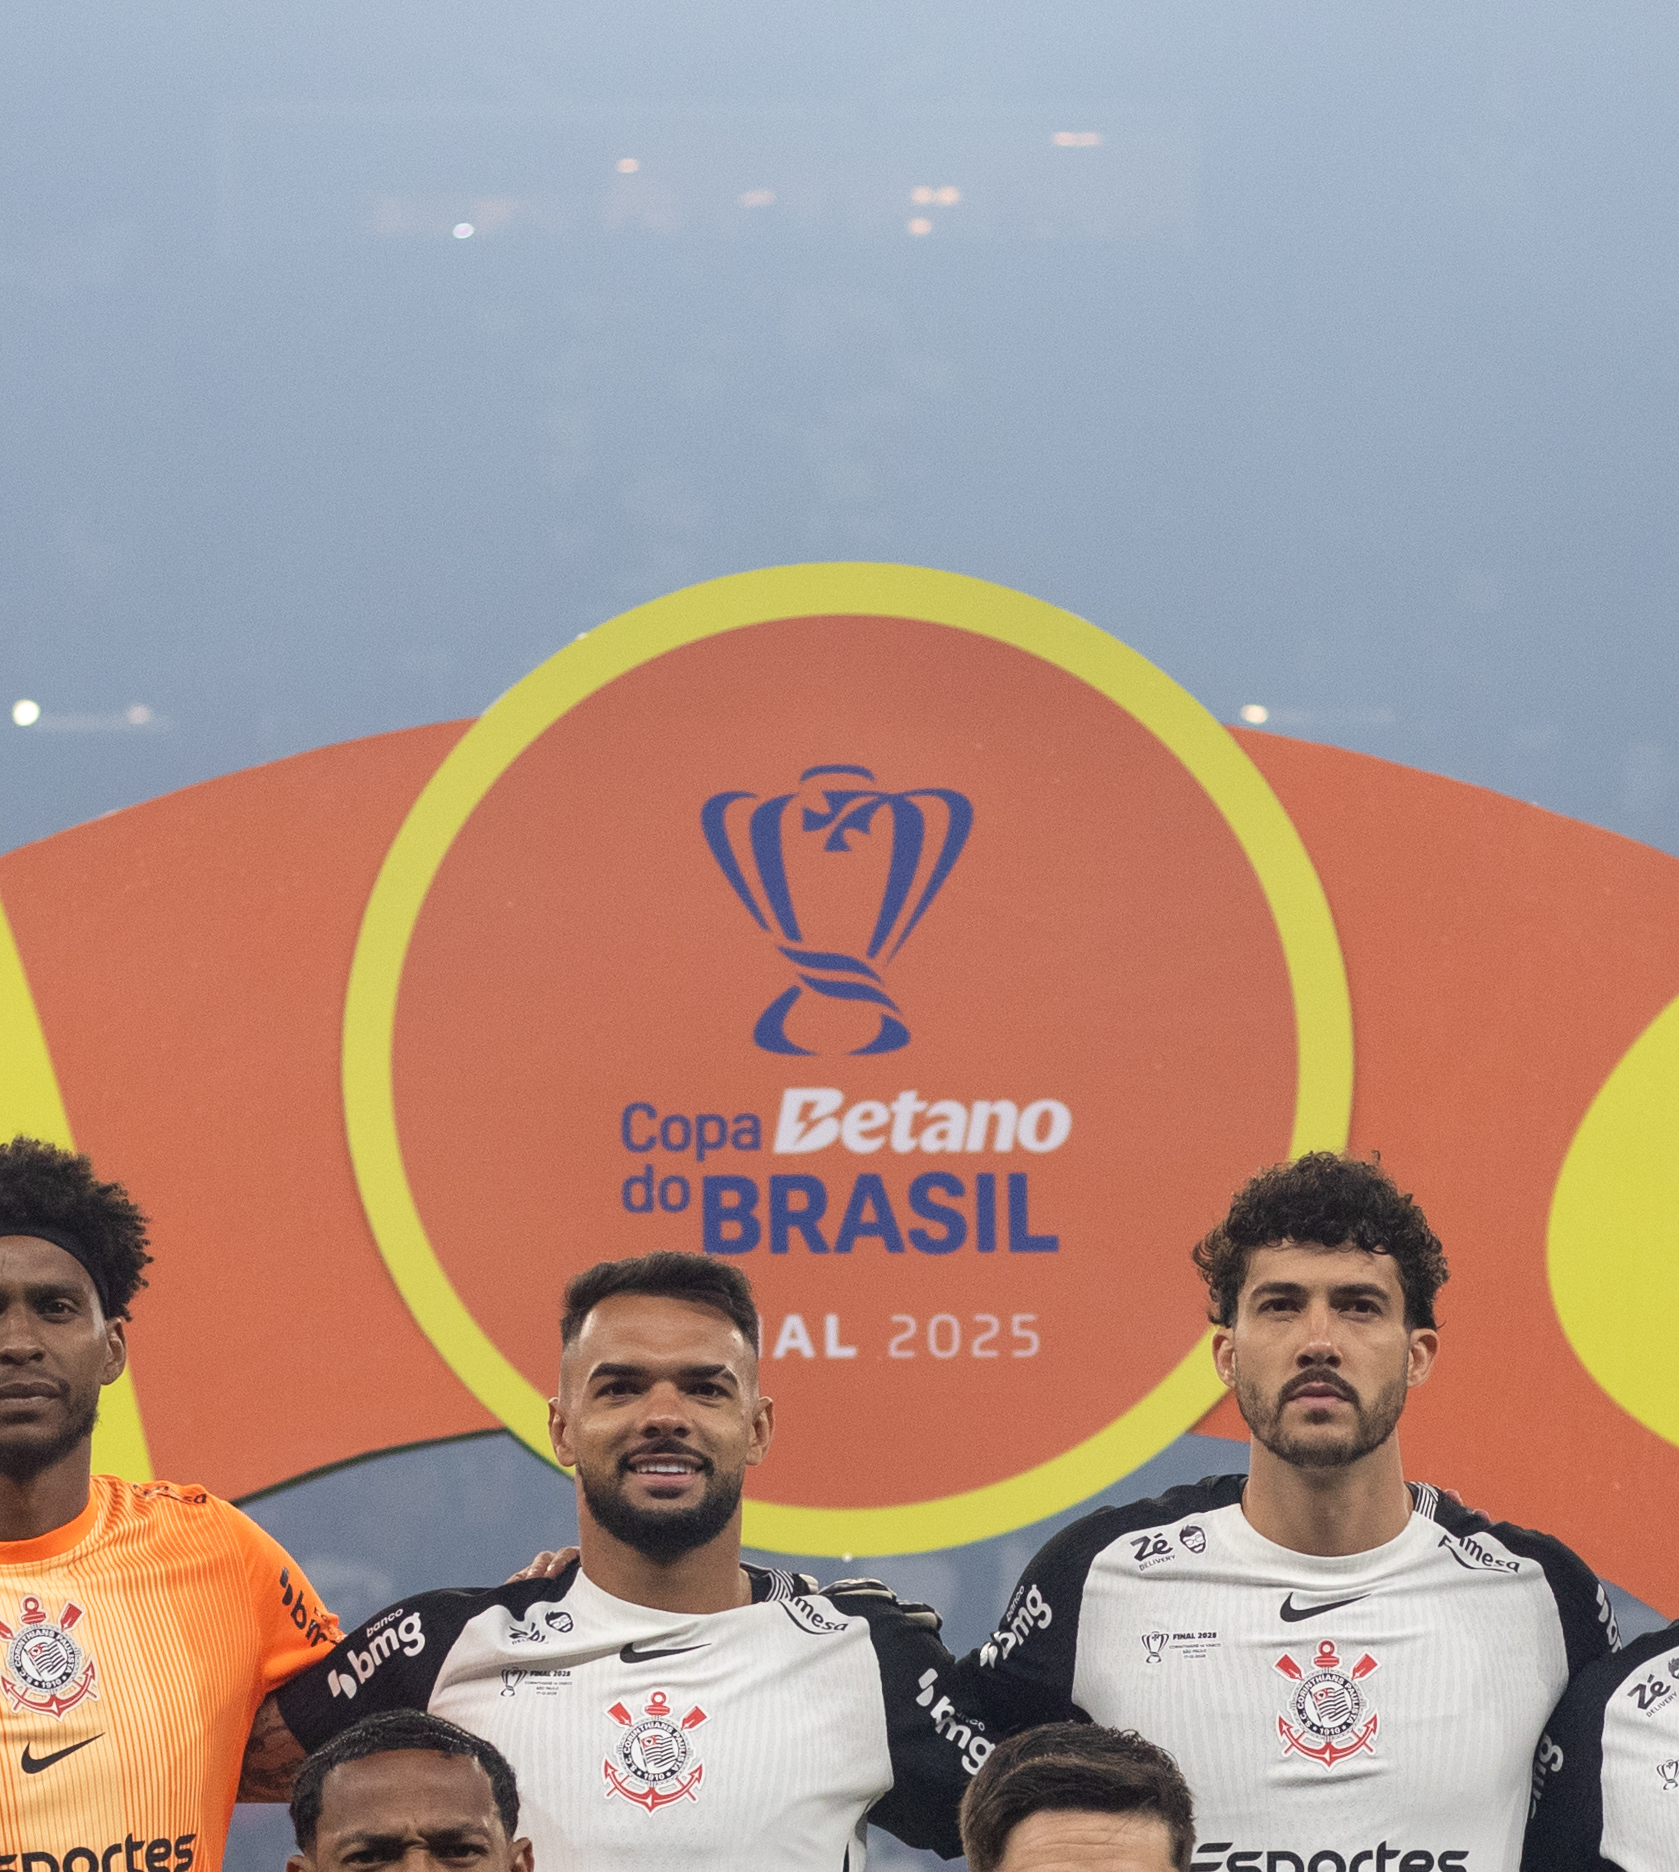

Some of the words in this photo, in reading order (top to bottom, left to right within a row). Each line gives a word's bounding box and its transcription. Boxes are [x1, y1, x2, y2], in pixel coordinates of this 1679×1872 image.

[620, 1101, 762, 1161] Copa
[773, 1086, 1073, 1156] Betano
[621, 1163, 691, 1213] do
[701, 1171, 1060, 1255] BRASIL
[888, 1313, 1041, 1359] 2025
[1130, 1532, 1174, 1562] Zé
[366, 1608, 404, 1638] banco
[1172, 1632, 1196, 1641] FINAL
[346, 1612, 426, 1685] bmg
[41, 1680, 62, 1689] 1910
[1627, 1674, 1671, 1711] Zé
[1320, 1726, 1341, 1736] 1910
[644, 1773, 665, 1781] 1910
